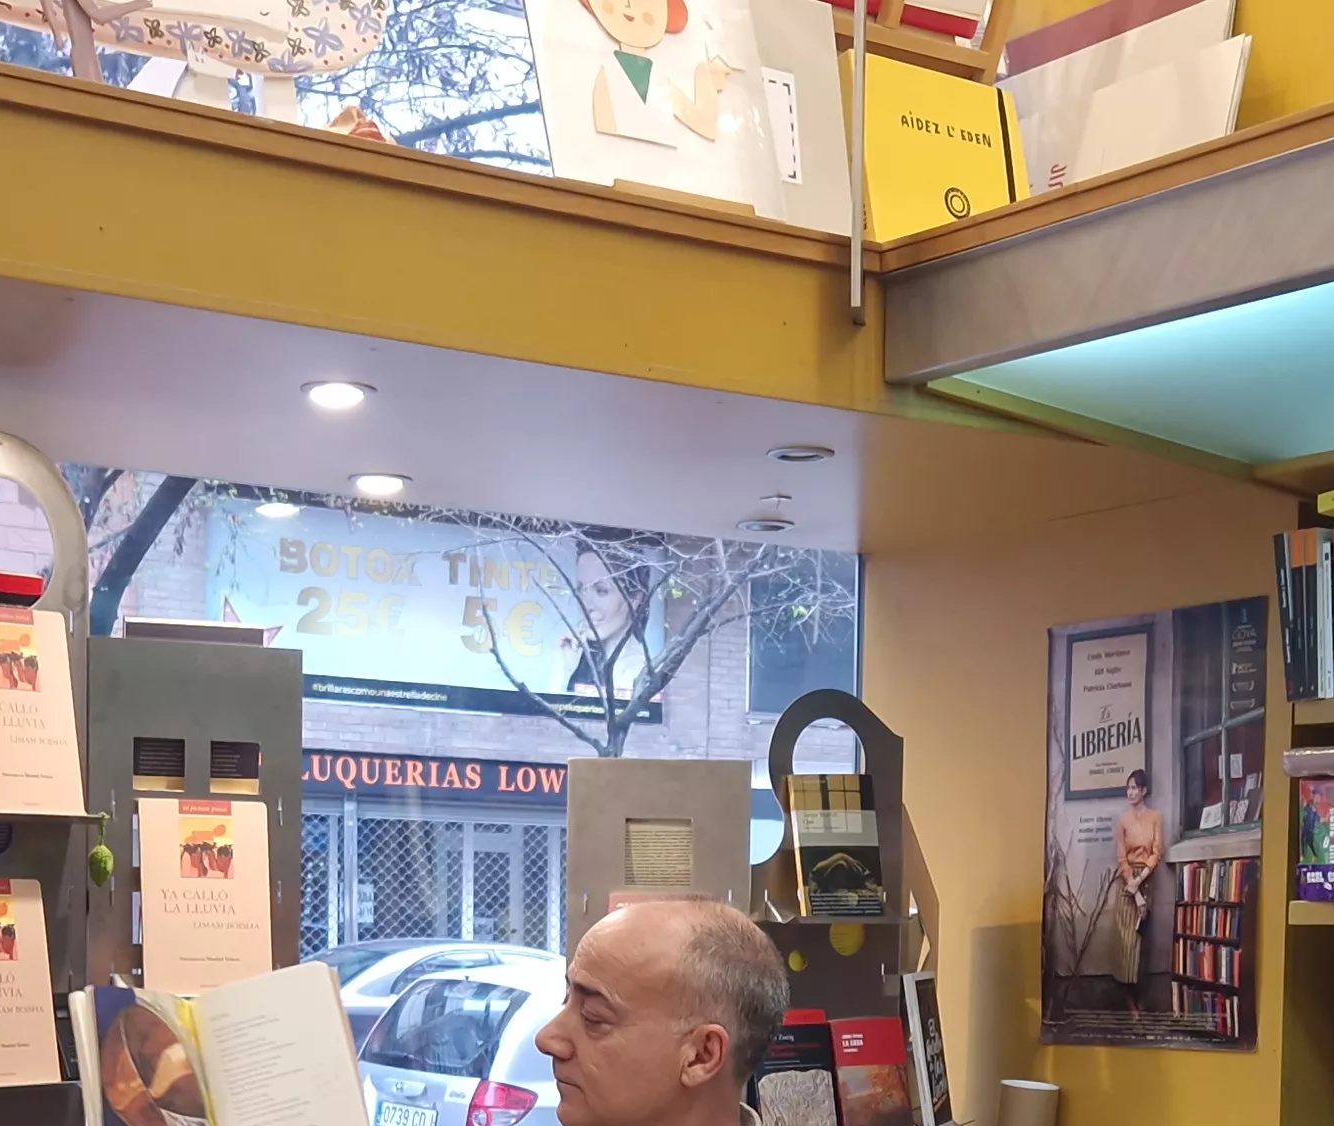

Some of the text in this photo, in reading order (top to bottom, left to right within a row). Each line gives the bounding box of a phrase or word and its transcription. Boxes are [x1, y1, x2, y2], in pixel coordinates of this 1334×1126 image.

[960, 129, 992, 148] EDEN
[279, 537, 422, 586] BOTOX
[296, 586, 544, 659] 25€ 5€
[1073, 712, 1142, 761] LIBRERÍA
[498, 766, 567, 793] LOW
[161, 889, 178, 901] YA
[164, 903, 236, 915] LA LLUVIA
[383, 1107, 409, 1126] 0739
